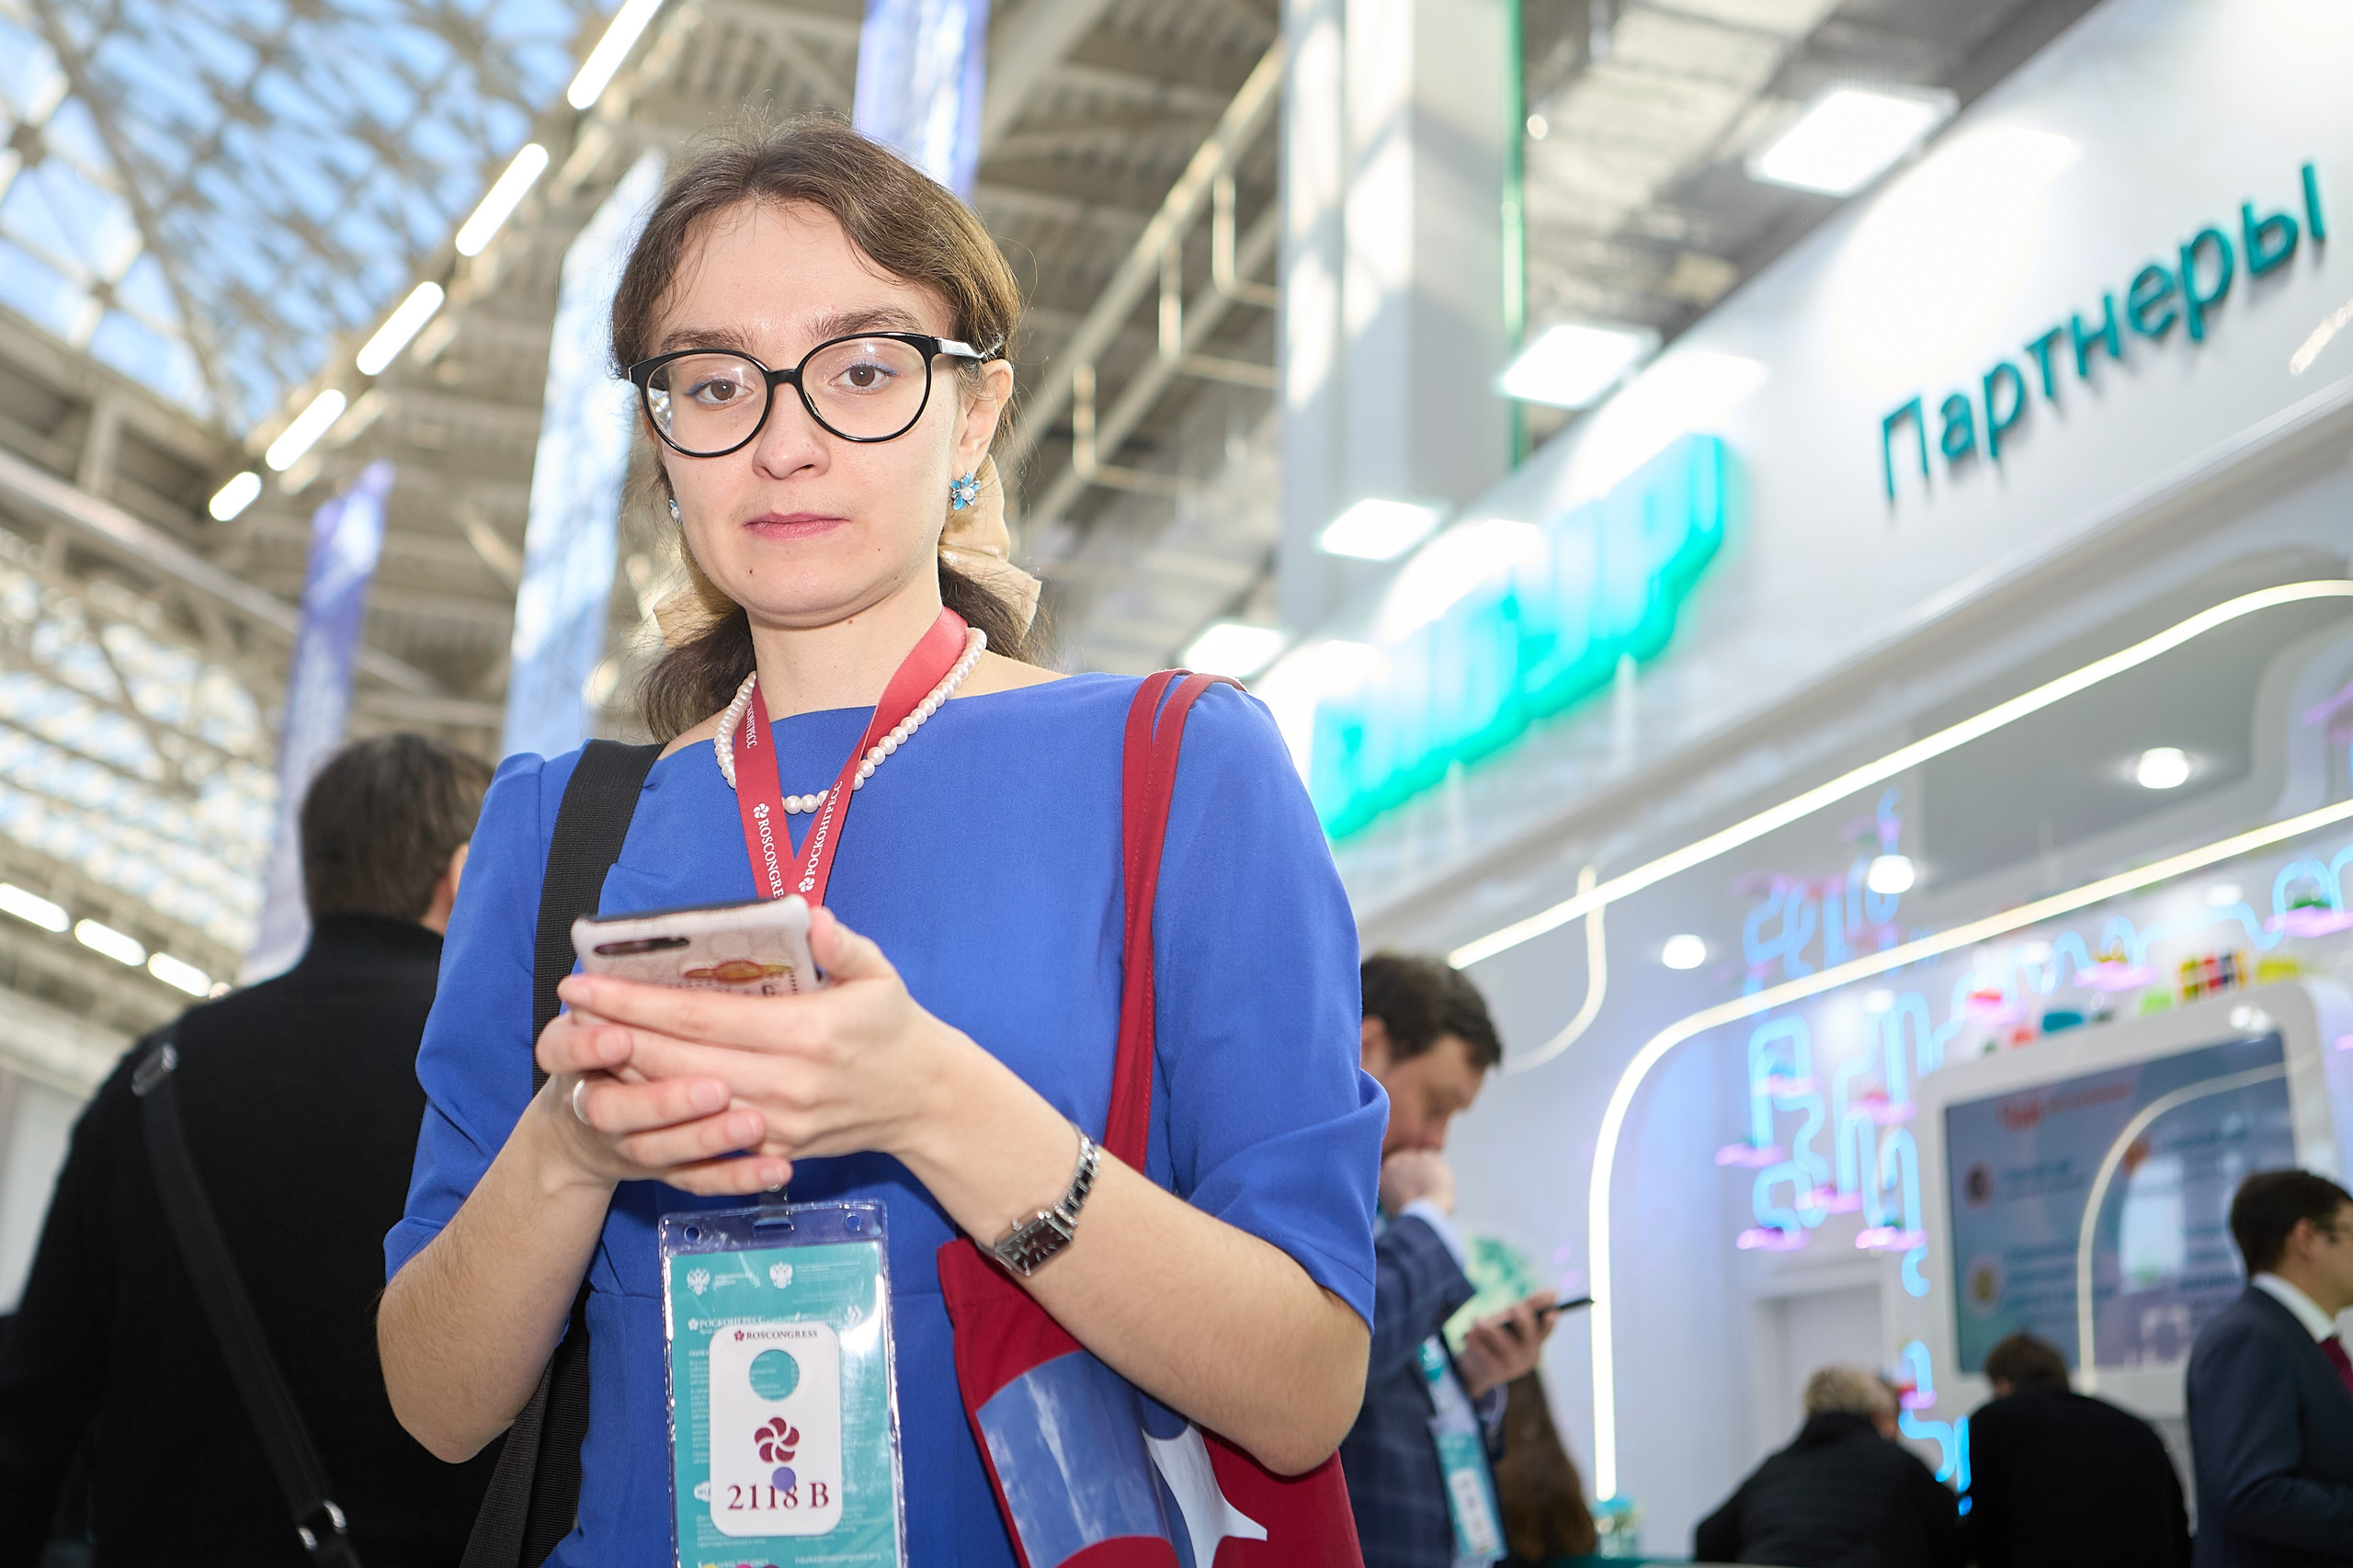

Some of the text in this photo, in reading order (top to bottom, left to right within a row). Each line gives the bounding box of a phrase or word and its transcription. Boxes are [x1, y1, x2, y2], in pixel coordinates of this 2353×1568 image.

[1881, 160, 2327, 501] Партнеры
[757, 818, 785, 900] ROSCONGRE
[805, 780, 843, 876] РОСКОНГРЕСС
[746, 1330, 818, 1340] ROSCONGRESS
[727, 1483, 799, 1510] 2118
[809, 1482, 830, 1509] B
